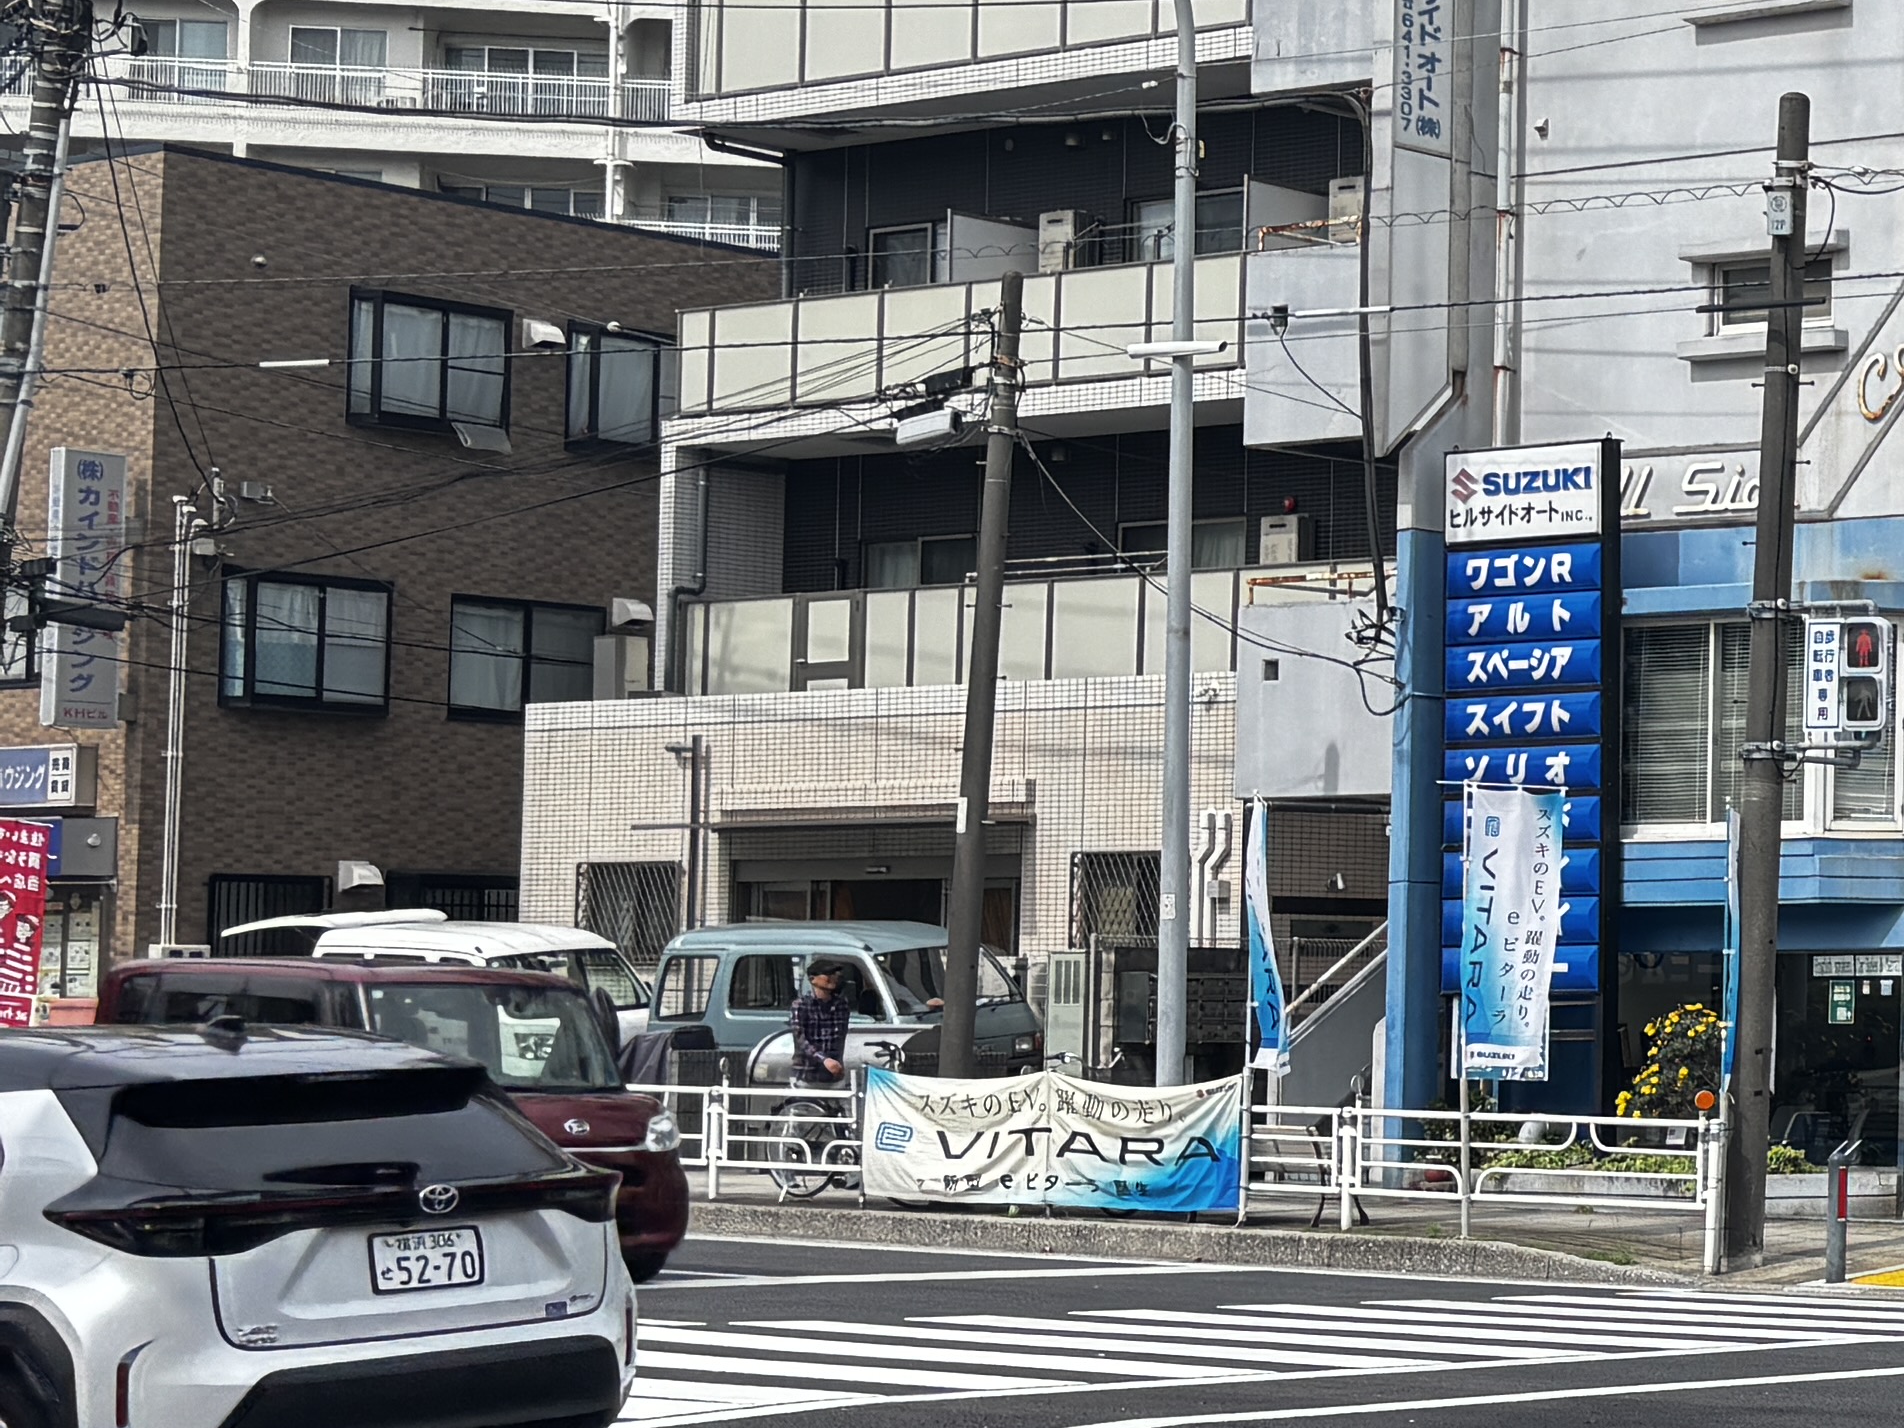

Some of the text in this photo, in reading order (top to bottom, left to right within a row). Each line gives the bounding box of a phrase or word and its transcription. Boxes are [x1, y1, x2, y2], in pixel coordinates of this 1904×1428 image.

[1482, 466, 1593, 497] SUZUKI
[1449, 500, 1559, 529] ヒルサイドオート
[1465, 552, 1573, 590] ワゴンR
[1466, 599, 1571, 636] アルト
[1466, 646, 1573, 684] スペーシア
[1465, 699, 1571, 736] スイフト
[1465, 751, 1571, 785] ソリオ
[1465, 848, 1499, 1022] VITARA
[936, 1127, 1220, 1167] VITARA
[396, 1249, 477, 1285] 52-70
